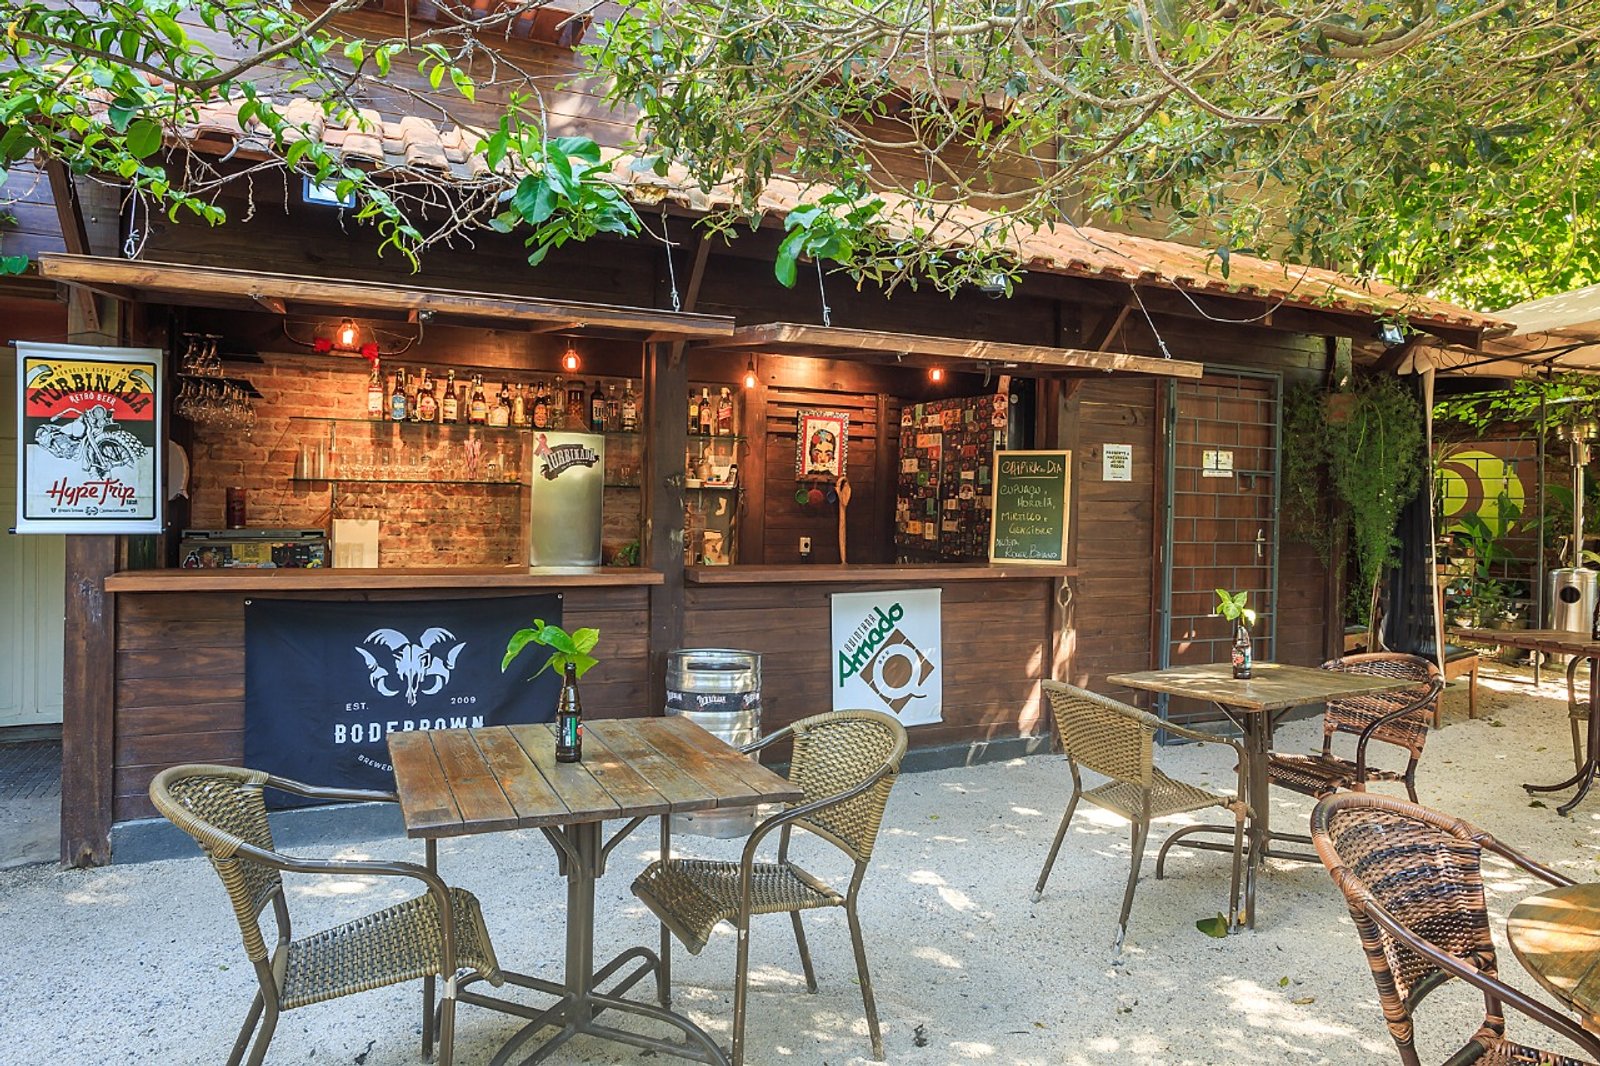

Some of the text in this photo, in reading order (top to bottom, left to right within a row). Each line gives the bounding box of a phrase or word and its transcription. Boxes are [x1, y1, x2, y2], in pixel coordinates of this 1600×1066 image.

[29, 373, 151, 414] TURBINADA
[96, 394, 116, 405] BEER
[839, 602, 904, 688] Amado
[345, 696, 477, 711] EST. 2009
[357, 754, 393, 772] BREWED
